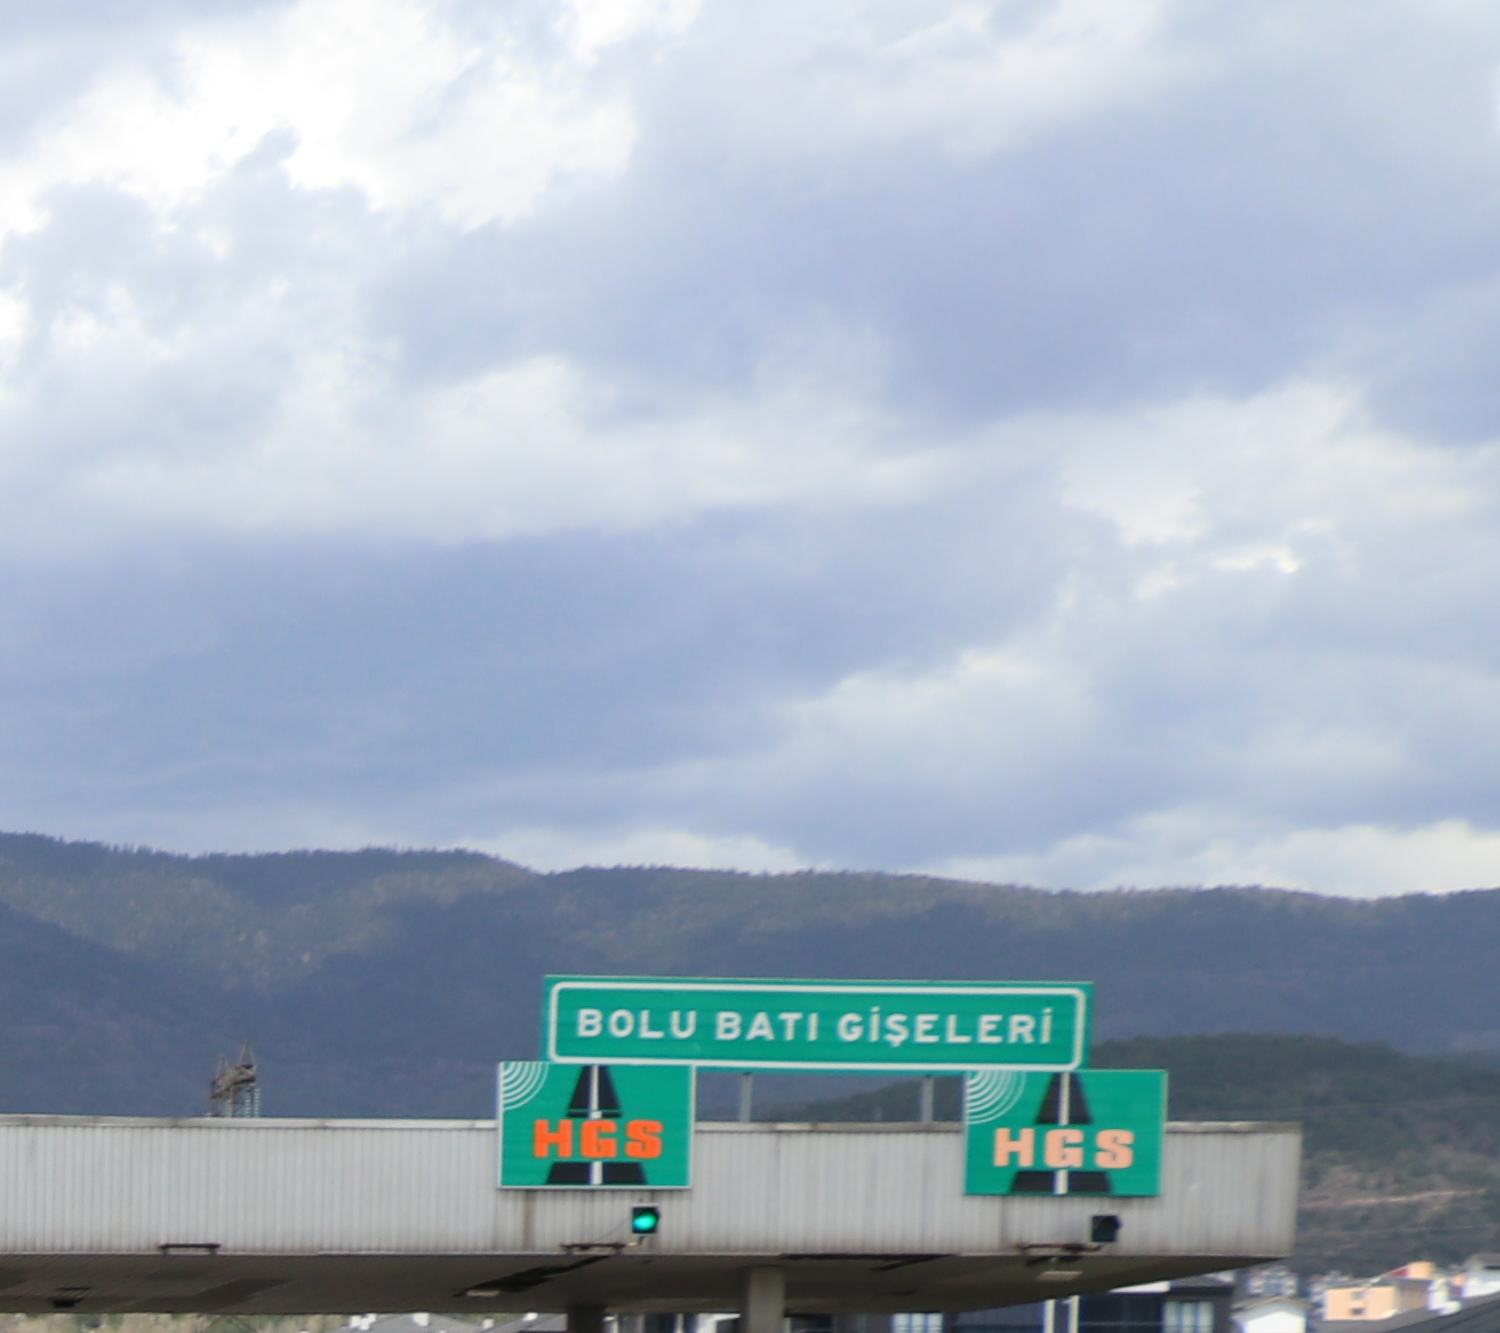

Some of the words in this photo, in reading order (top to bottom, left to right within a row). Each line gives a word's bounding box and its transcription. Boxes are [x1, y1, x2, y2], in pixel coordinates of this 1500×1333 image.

[577, 1008, 697, 1039] BOLU
[715, 1011, 819, 1041] BATI
[837, 1005, 1053, 1048] GİŞELERİ
[533, 1118, 663, 1159] HGS
[993, 1127, 1134, 1169] HGS
